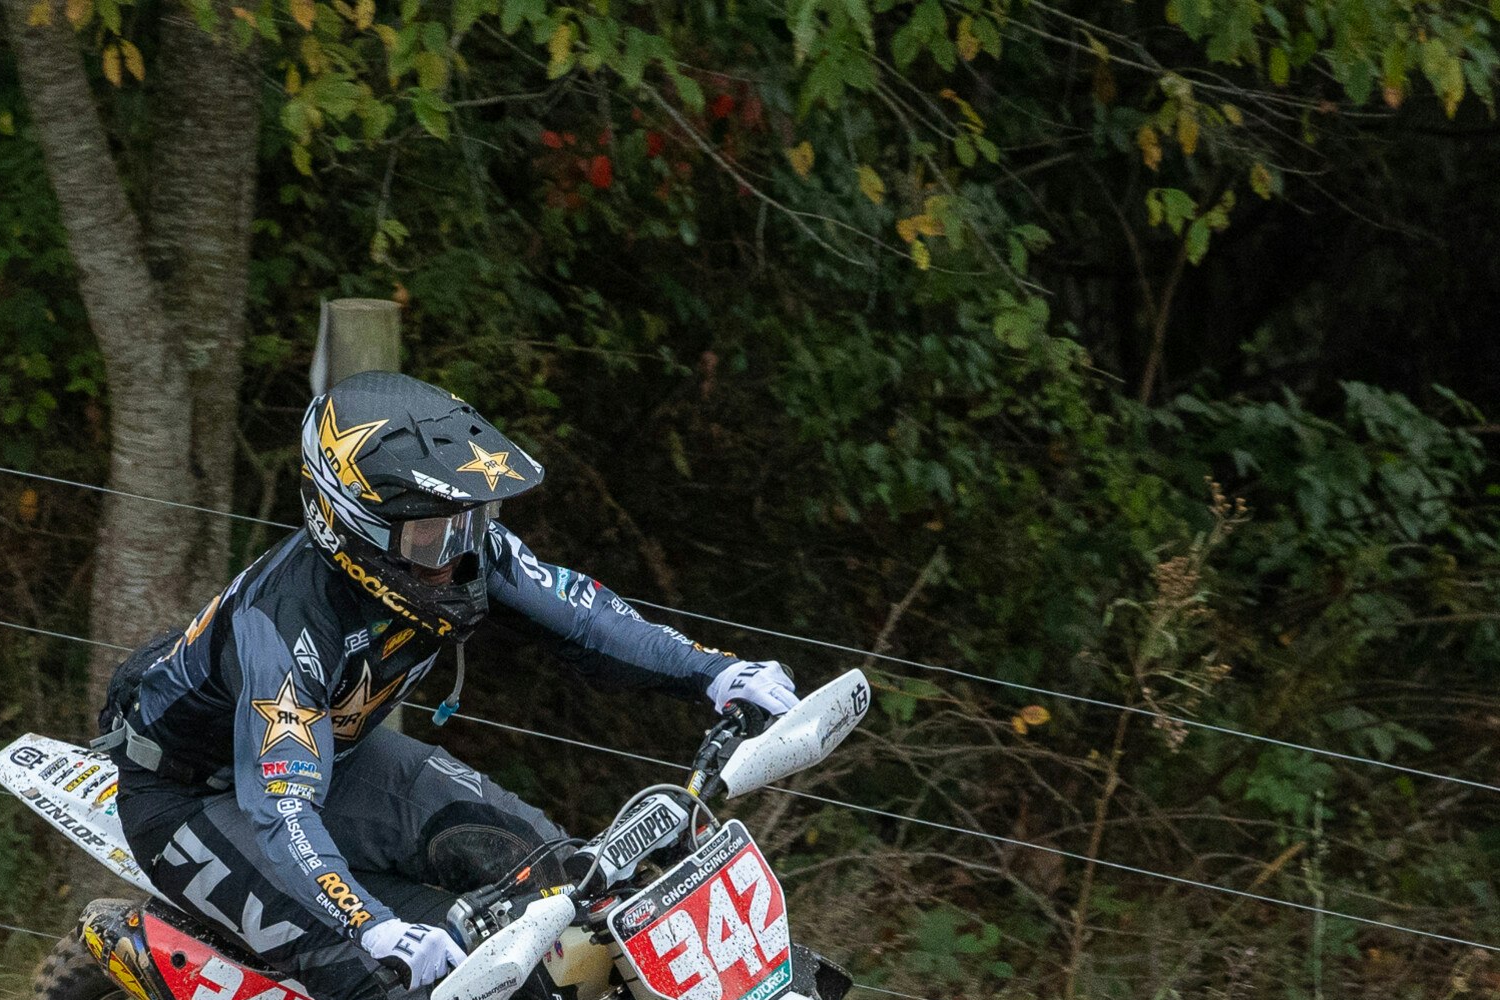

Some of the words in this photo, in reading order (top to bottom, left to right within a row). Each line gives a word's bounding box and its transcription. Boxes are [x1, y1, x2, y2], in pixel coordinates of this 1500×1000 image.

[729, 663, 767, 692] FLY
[262, 762, 287, 778] RK
[20, 787, 107, 851] DUNLOP
[606, 804, 676, 868] PROTAPER
[701, 834, 726, 857] DELONG
[162, 822, 308, 953] FLY
[662, 837, 745, 907] GNCCRACING.COM
[392, 924, 432, 957] FLY
